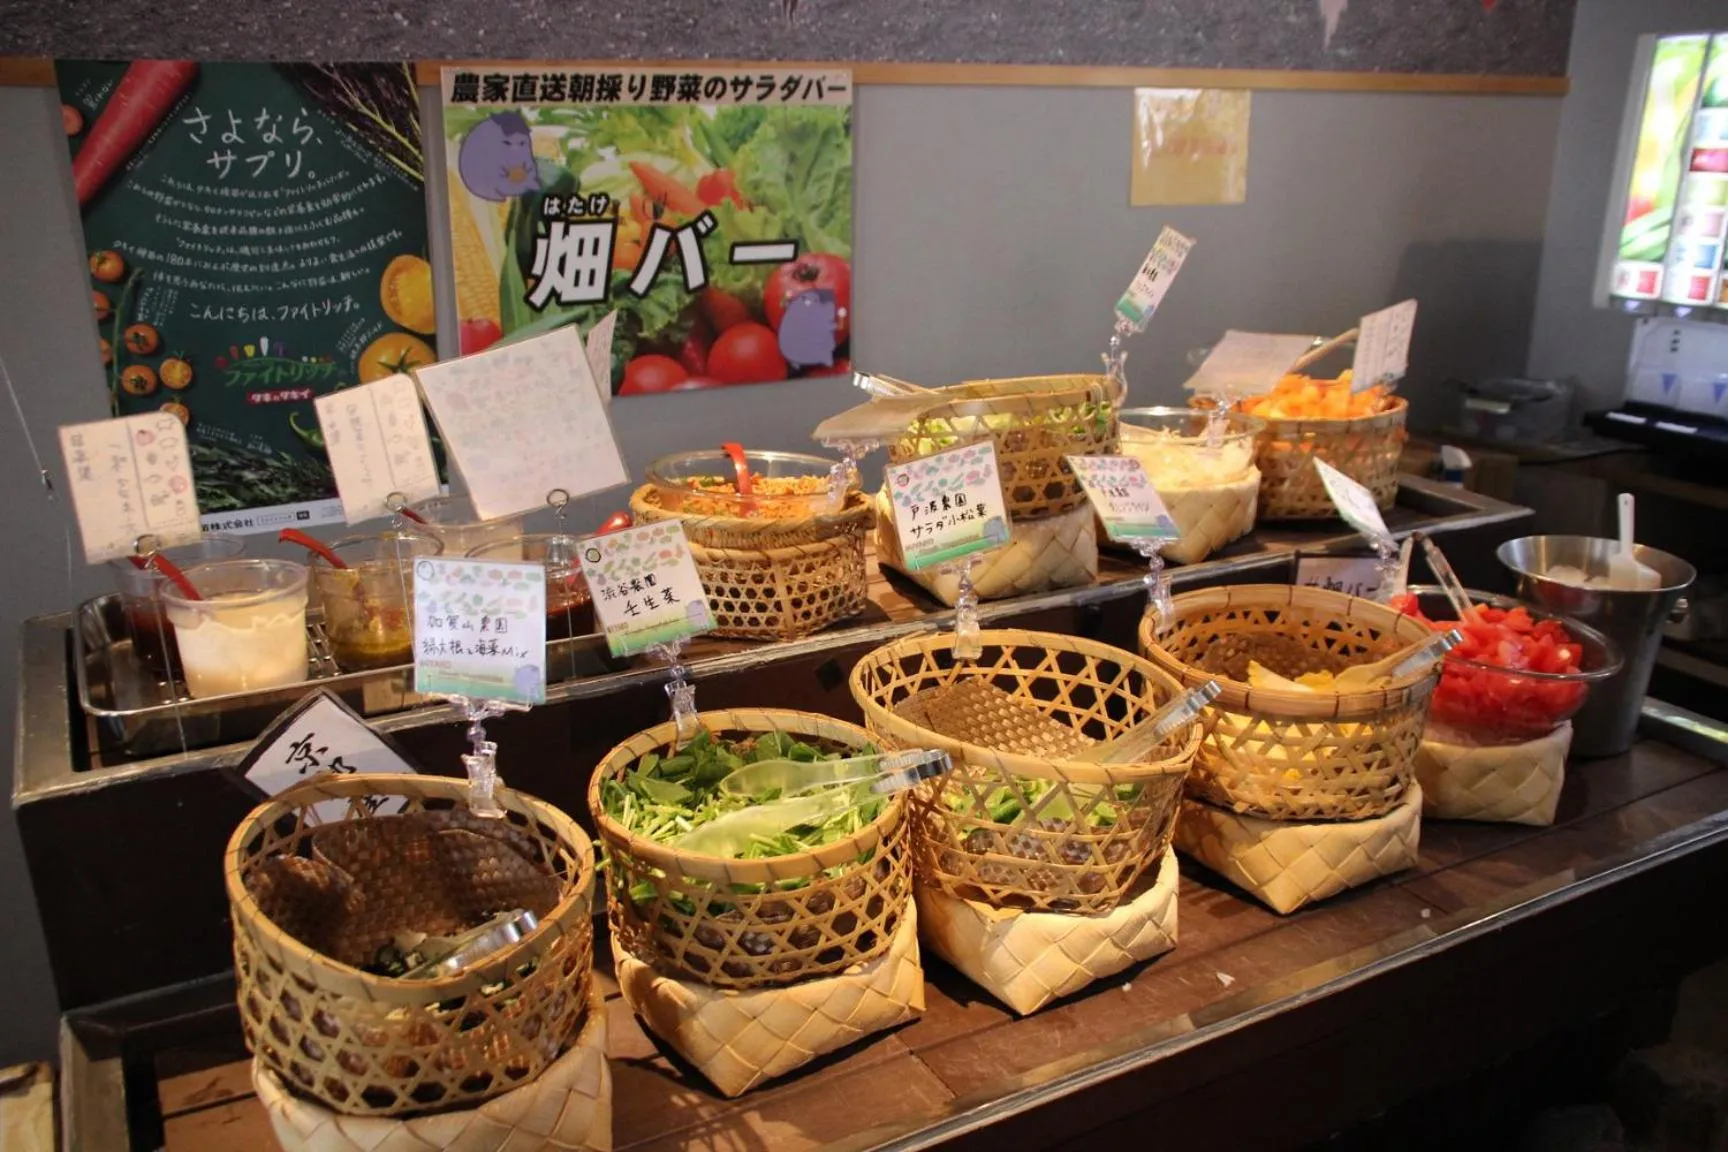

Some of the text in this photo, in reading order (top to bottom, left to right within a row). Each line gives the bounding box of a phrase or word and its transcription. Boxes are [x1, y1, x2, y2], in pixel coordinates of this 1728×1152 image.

[451, 72, 846, 102] 農家直送朝採り野菜のサラダバー
[183, 105, 323, 145] さよなら、
[206, 150, 316, 179] サプリ。
[544, 196, 608, 216] はたけ
[527, 211, 797, 310] 畑バー
[190, 294, 360, 323] こんにちは、ファイトリッチ。
